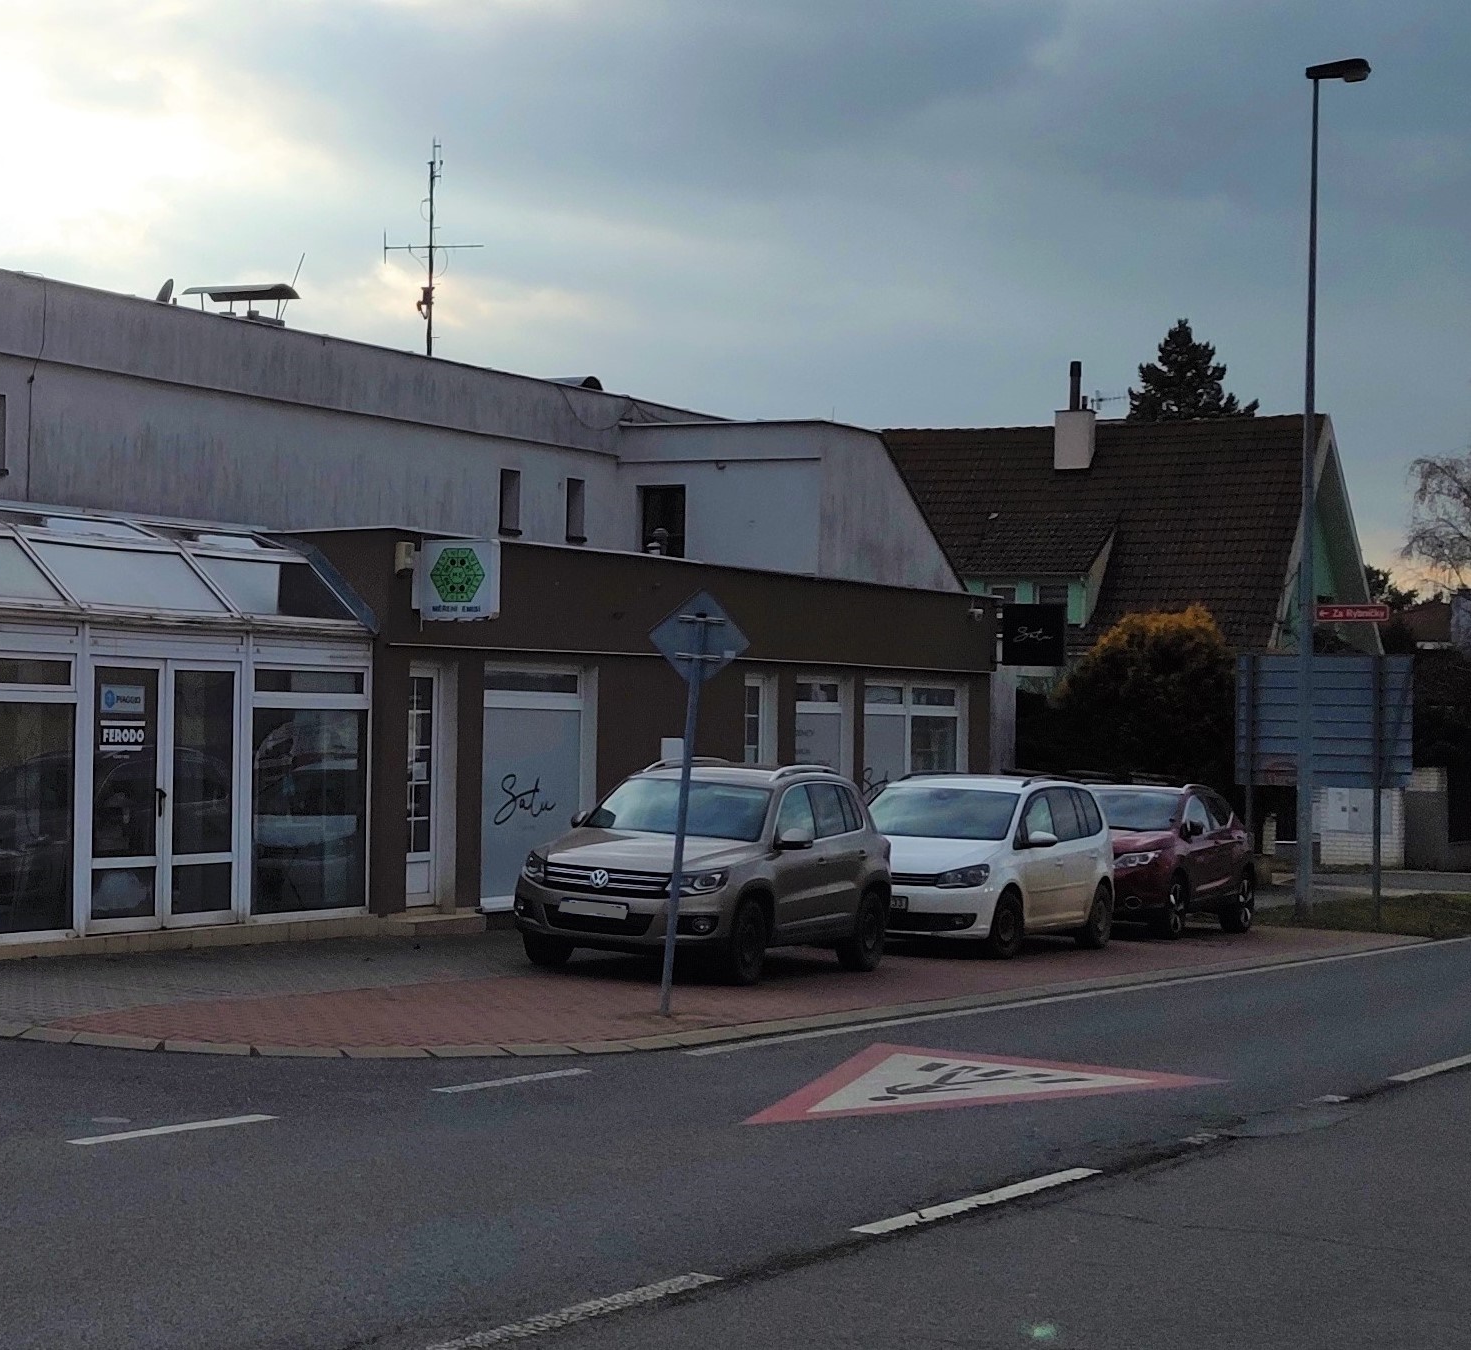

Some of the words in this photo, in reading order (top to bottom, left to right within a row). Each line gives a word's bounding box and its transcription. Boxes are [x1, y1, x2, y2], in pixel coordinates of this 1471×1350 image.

[1332, 608, 1344, 618] Za
[102, 728, 145, 743] FERODO
[494, 773, 557, 826] Satu
